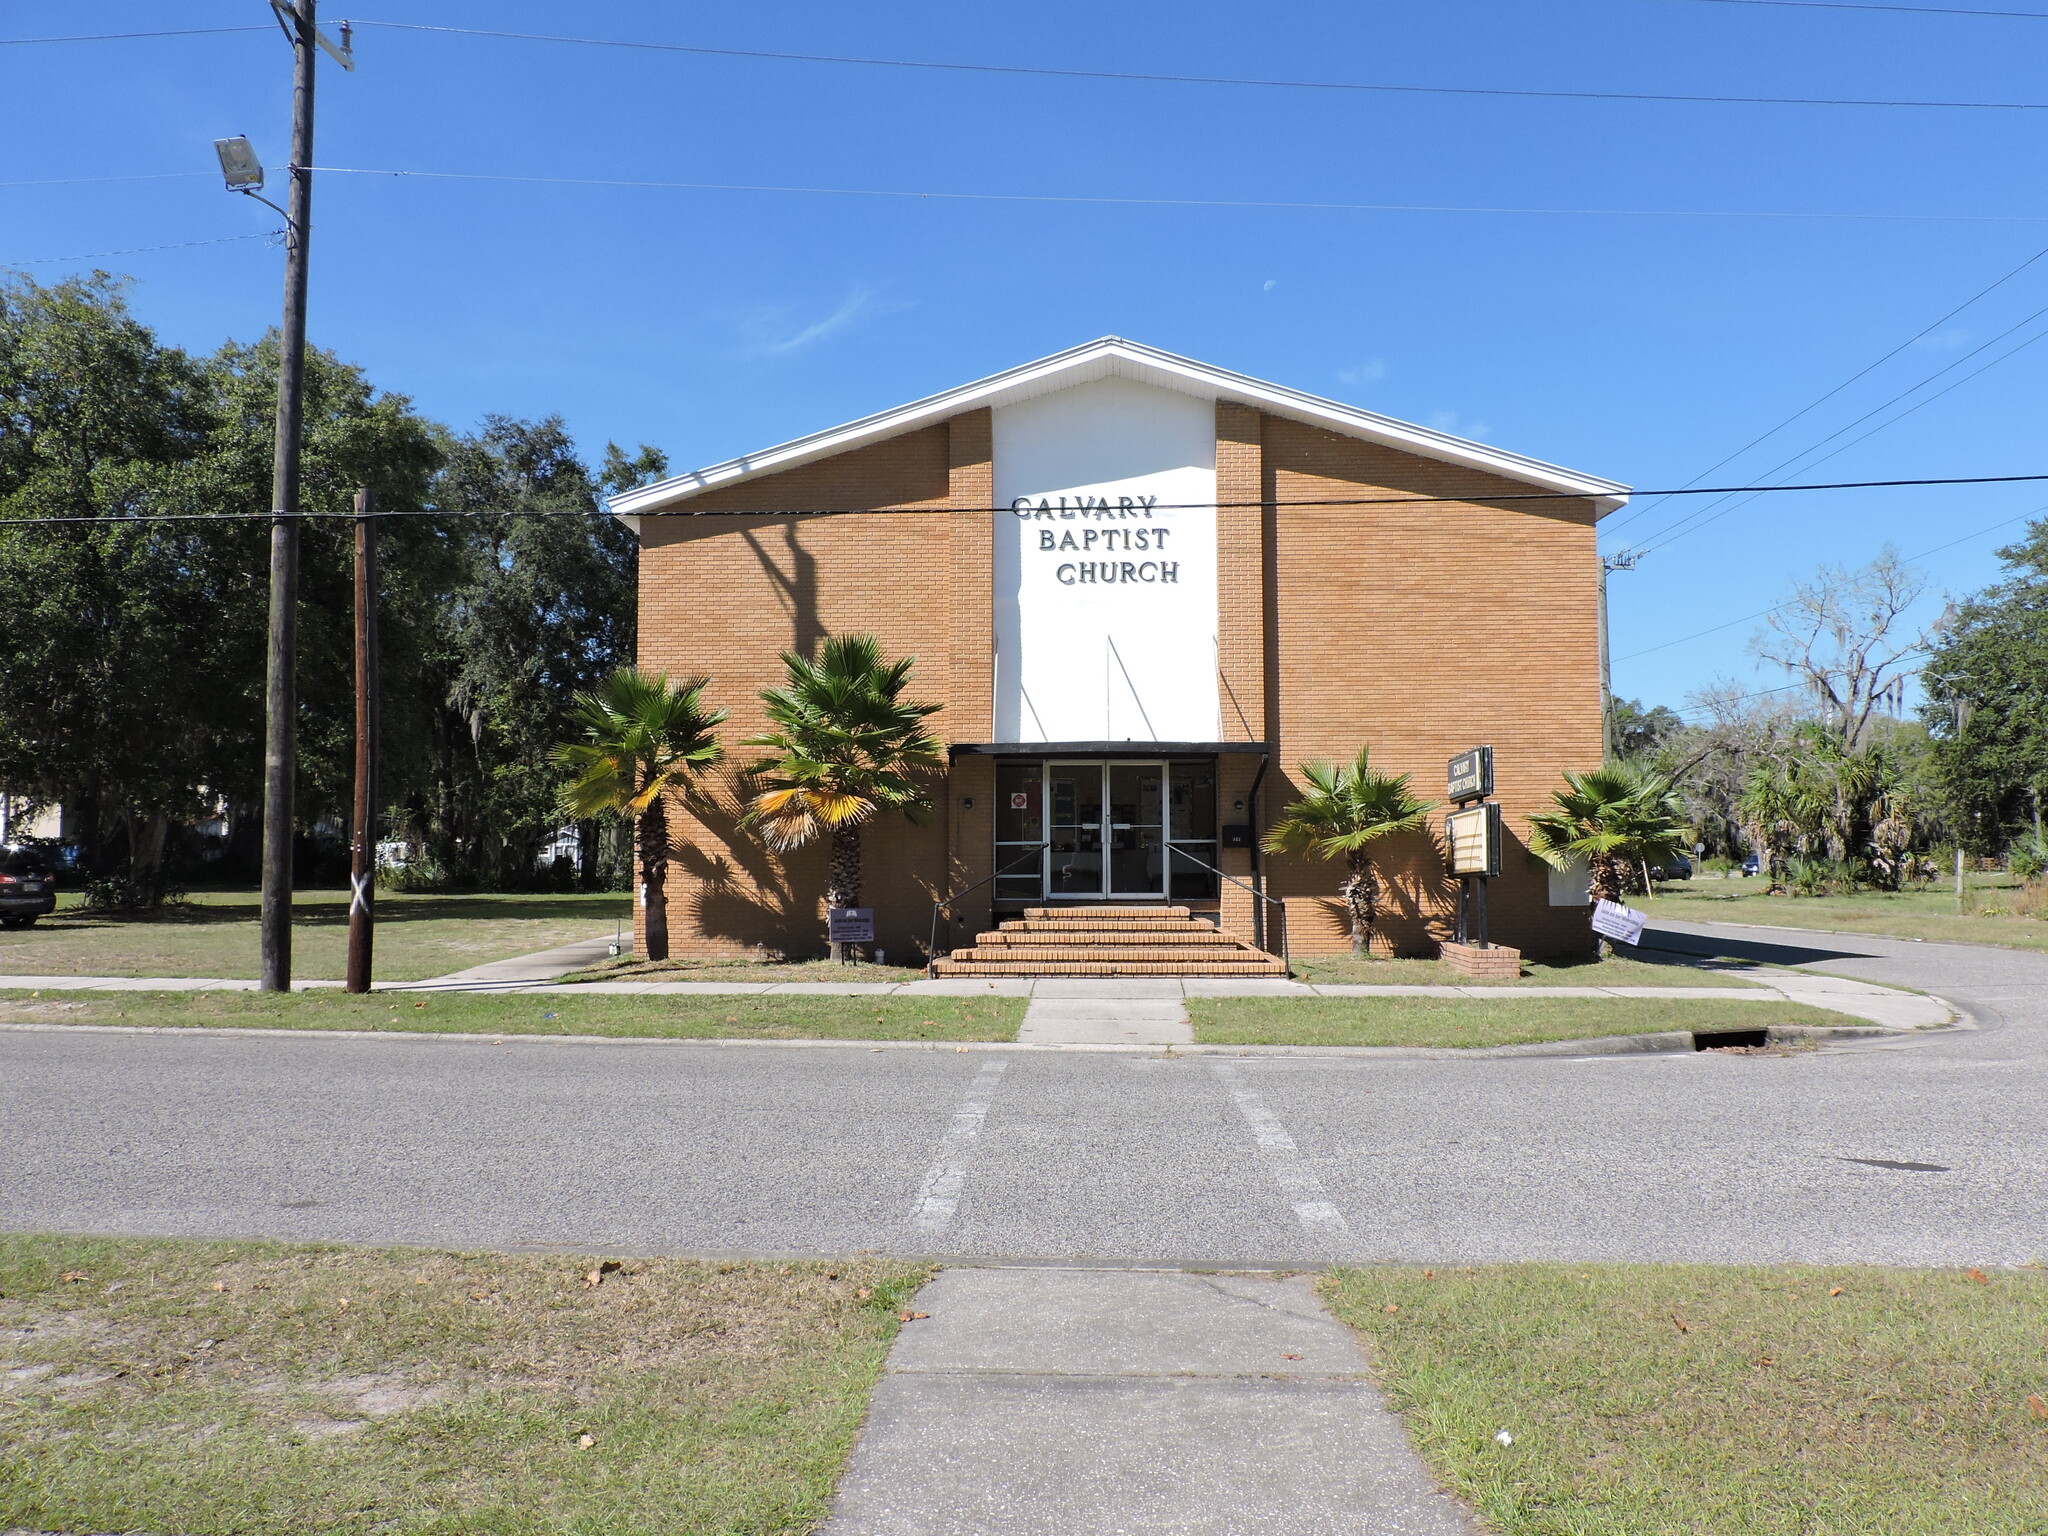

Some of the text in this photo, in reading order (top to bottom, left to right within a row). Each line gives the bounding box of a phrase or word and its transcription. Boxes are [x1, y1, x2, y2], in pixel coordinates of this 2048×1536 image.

[1012, 495, 1156, 519] CALVARY
[1039, 528, 1170, 551] BAPTIST
[1056, 561, 1180, 585] CHURCH
[1454, 760, 1470, 776] CALVARY
[1448, 774, 1476, 794] BAPTIST CHURCH
